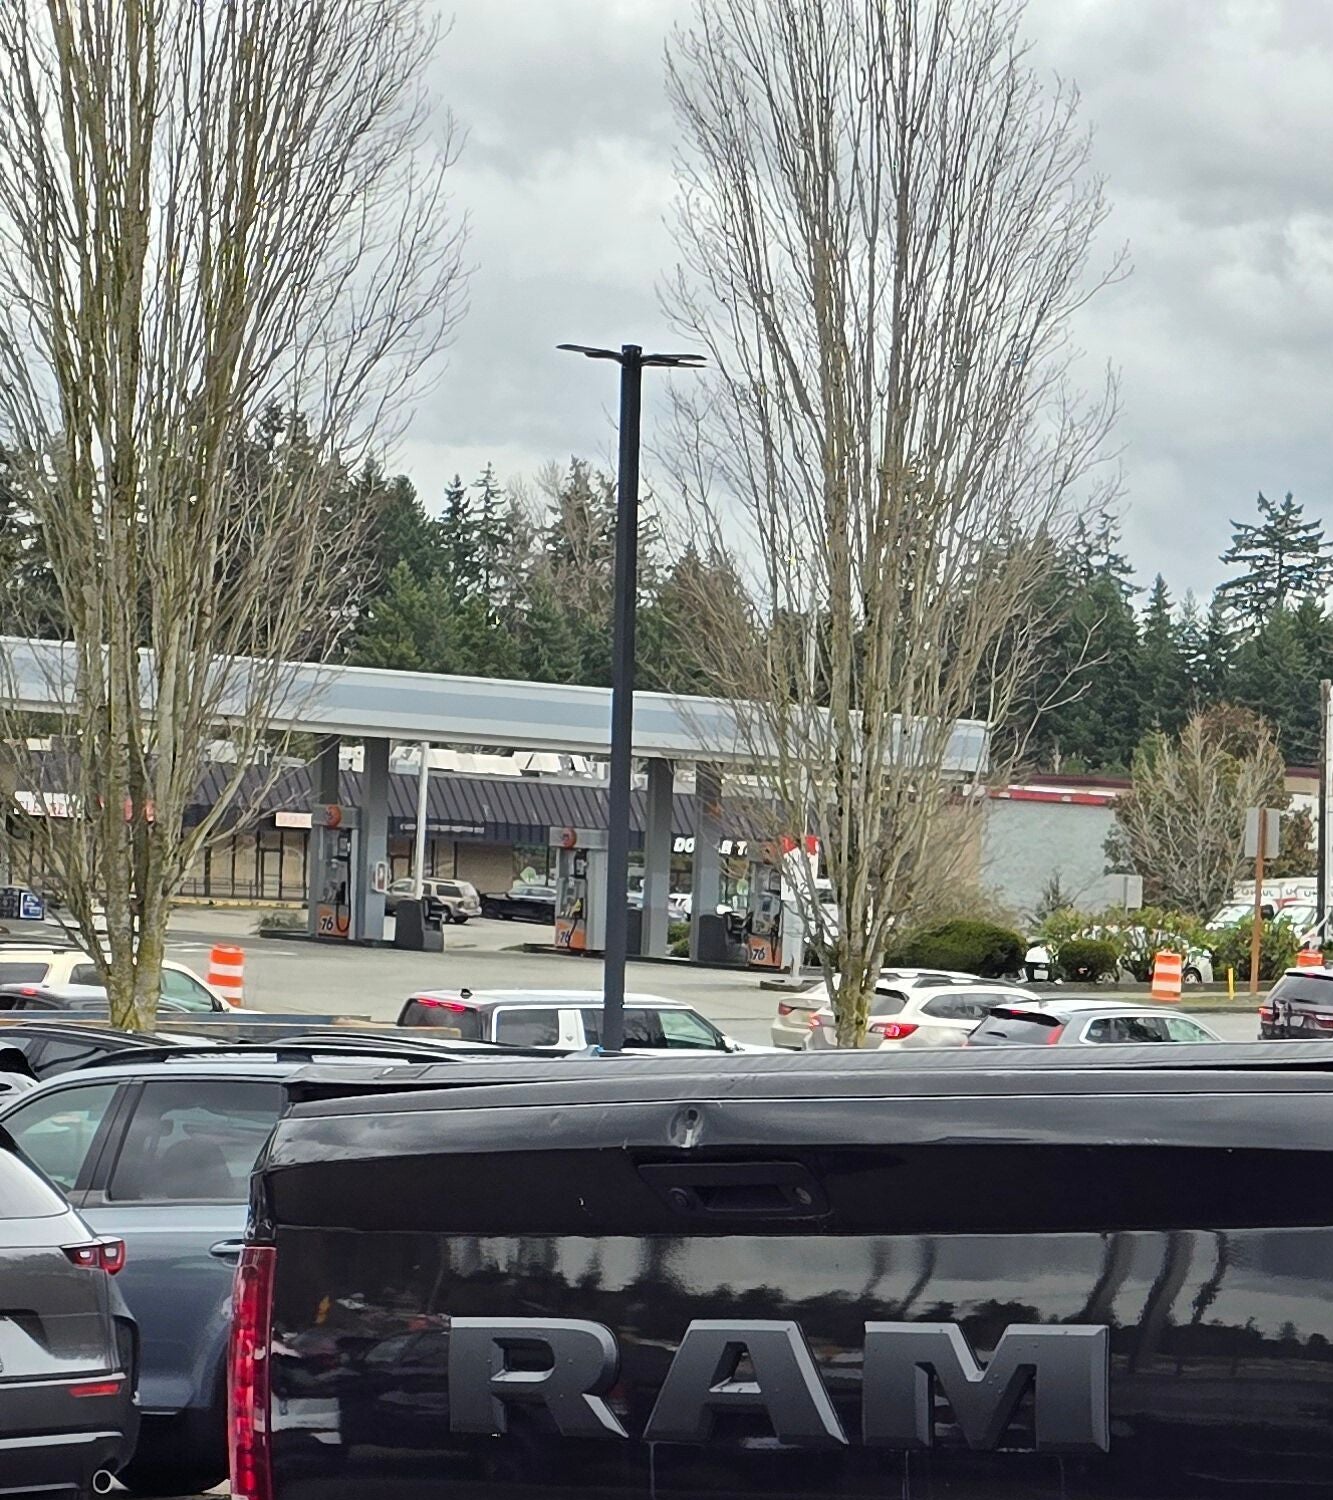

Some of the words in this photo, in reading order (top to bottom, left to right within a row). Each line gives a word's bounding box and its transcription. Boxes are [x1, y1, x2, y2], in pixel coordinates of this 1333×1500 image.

[320, 916, 334, 931] 76
[751, 948, 766, 961] 76
[449, 1316, 1112, 1453] RAM
